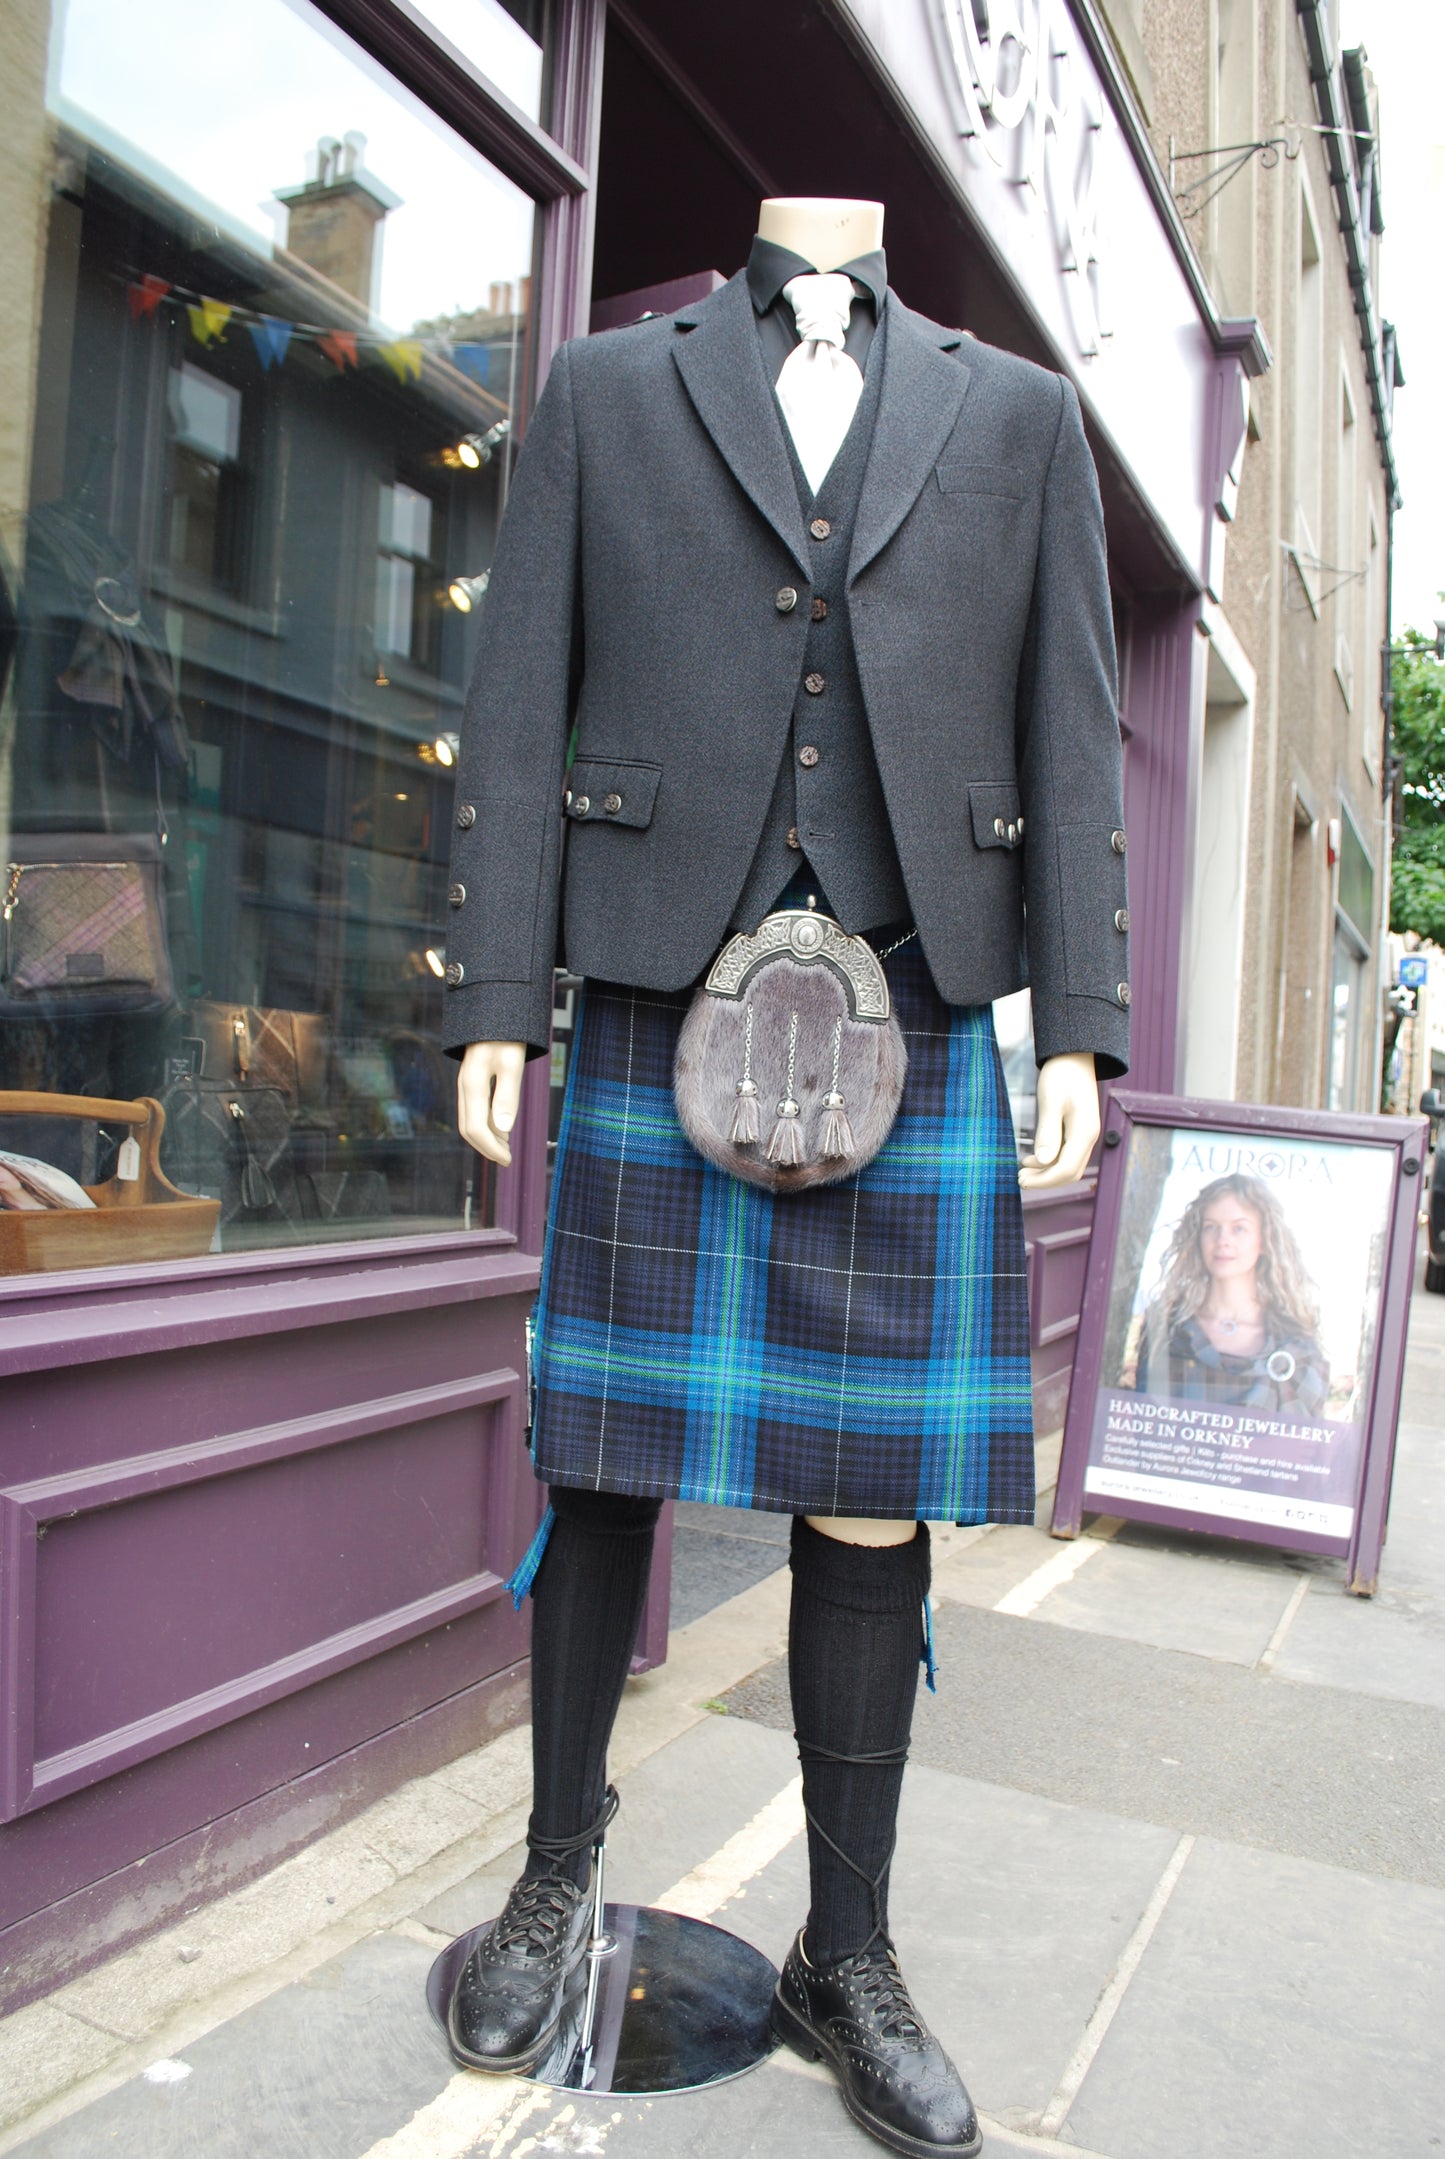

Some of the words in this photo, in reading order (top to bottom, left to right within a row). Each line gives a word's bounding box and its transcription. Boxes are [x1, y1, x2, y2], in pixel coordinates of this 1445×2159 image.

[1181, 1145, 1333, 1184] AURORA
[1107, 1417, 1154, 1435] MADE
[1158, 1423, 1177, 1438] IN
[1180, 1427, 1254, 1449] ORKNEY
[1109, 1399, 1233, 1428] HANDCRAFTED
[1235, 1417, 1336, 1444] JEWELLERY
[1140, 1460, 1152, 1471] by
[1152, 1462, 1179, 1474] Aurora
[1217, 1474, 1242, 1484] range
[1176, 1454, 1186, 1464] of
[1186, 1455, 1214, 1469] Orkney
[1215, 1461, 1232, 1471] and
[1233, 1463, 1270, 1477] Shetland
[1220, 1451, 1258, 1464] purchase
[1260, 1457, 1276, 1467] and
[1294, 1463, 1331, 1475] available
